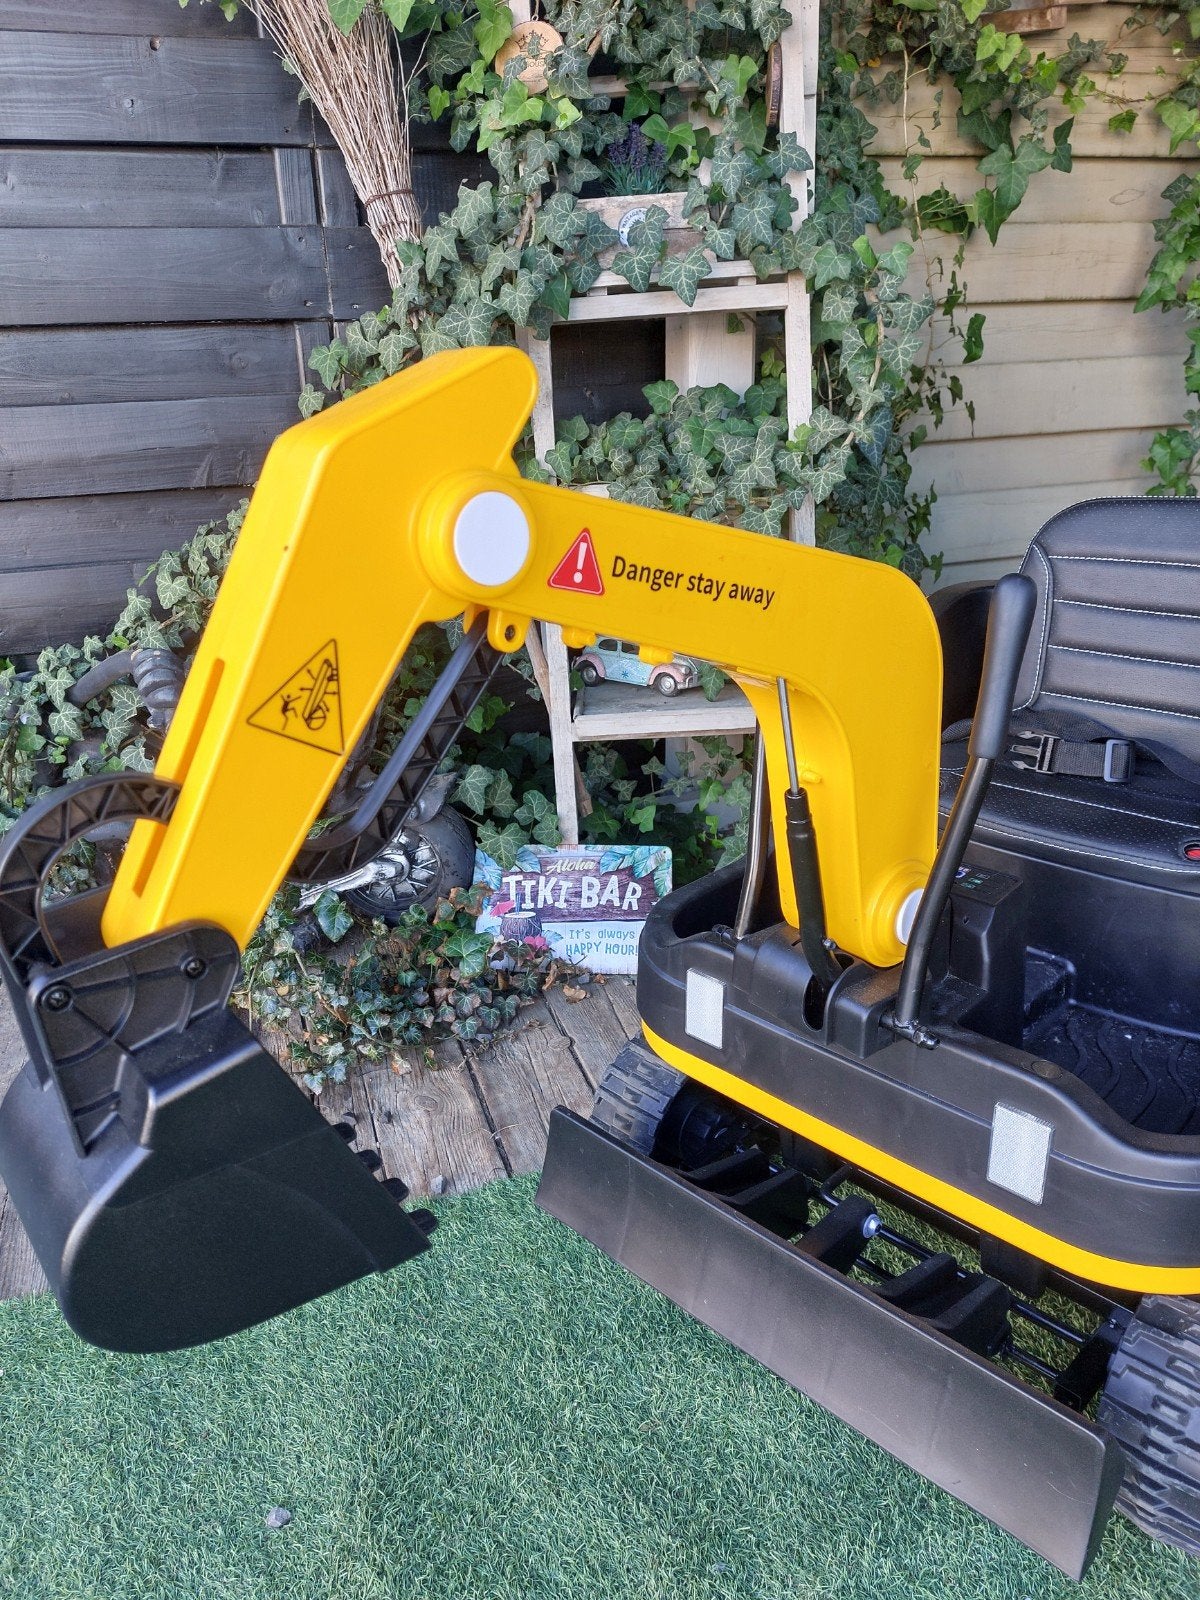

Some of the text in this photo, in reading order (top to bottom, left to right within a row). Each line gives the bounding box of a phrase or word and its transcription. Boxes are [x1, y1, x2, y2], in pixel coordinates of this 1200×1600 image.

[611, 555, 776, 611] Danger stay away
[545, 859, 596, 876] Aloha
[502, 874, 642, 911] TIKI BAR
[569, 928, 636, 941] It's always
[565, 941, 638, 957] HAPPY HOUR!
